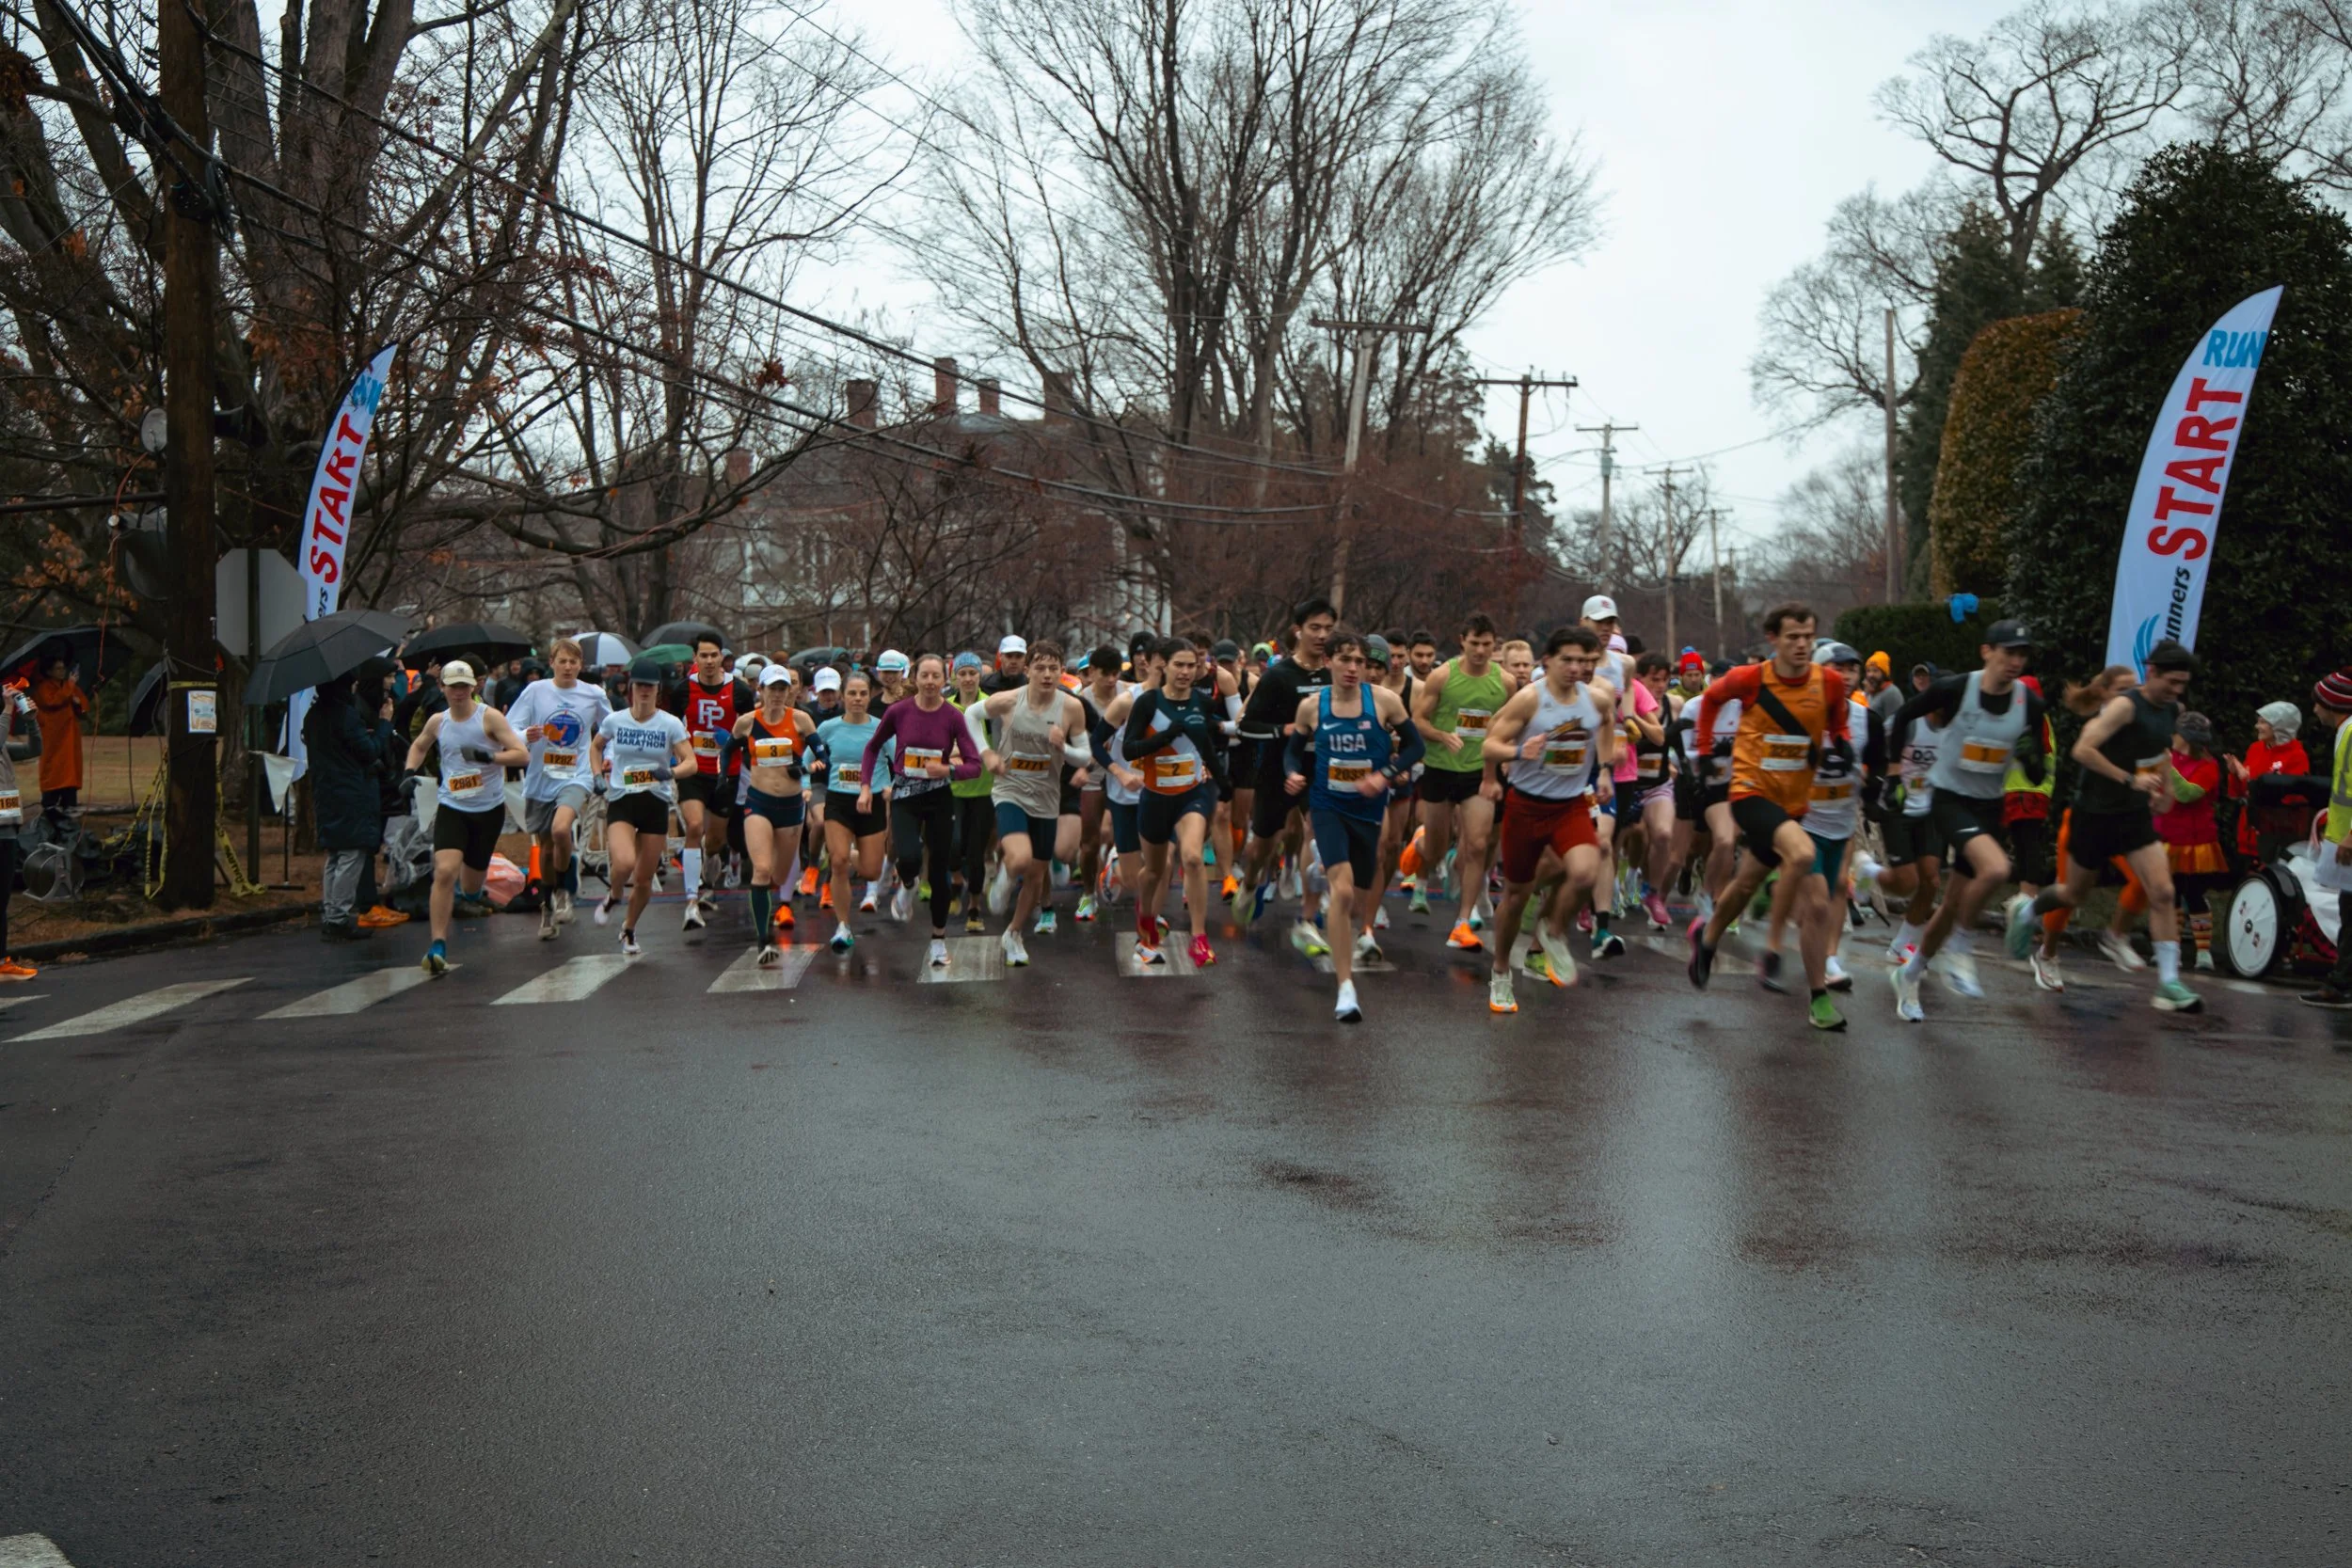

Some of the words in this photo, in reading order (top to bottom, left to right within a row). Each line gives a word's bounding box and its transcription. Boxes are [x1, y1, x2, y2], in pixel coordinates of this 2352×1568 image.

[2202, 330, 2267, 369] RUN
[2147, 376, 2244, 561] START
[309, 413, 364, 584] START
[2165, 564, 2191, 641] unners
[698, 699, 724, 729] FP
[617, 731, 666, 741] HAMPTONS
[617, 737, 666, 749] MARATHON
[1328, 733, 1366, 752] USA
[771, 745, 777, 757] 3
[1172, 763, 1180, 776] 2
